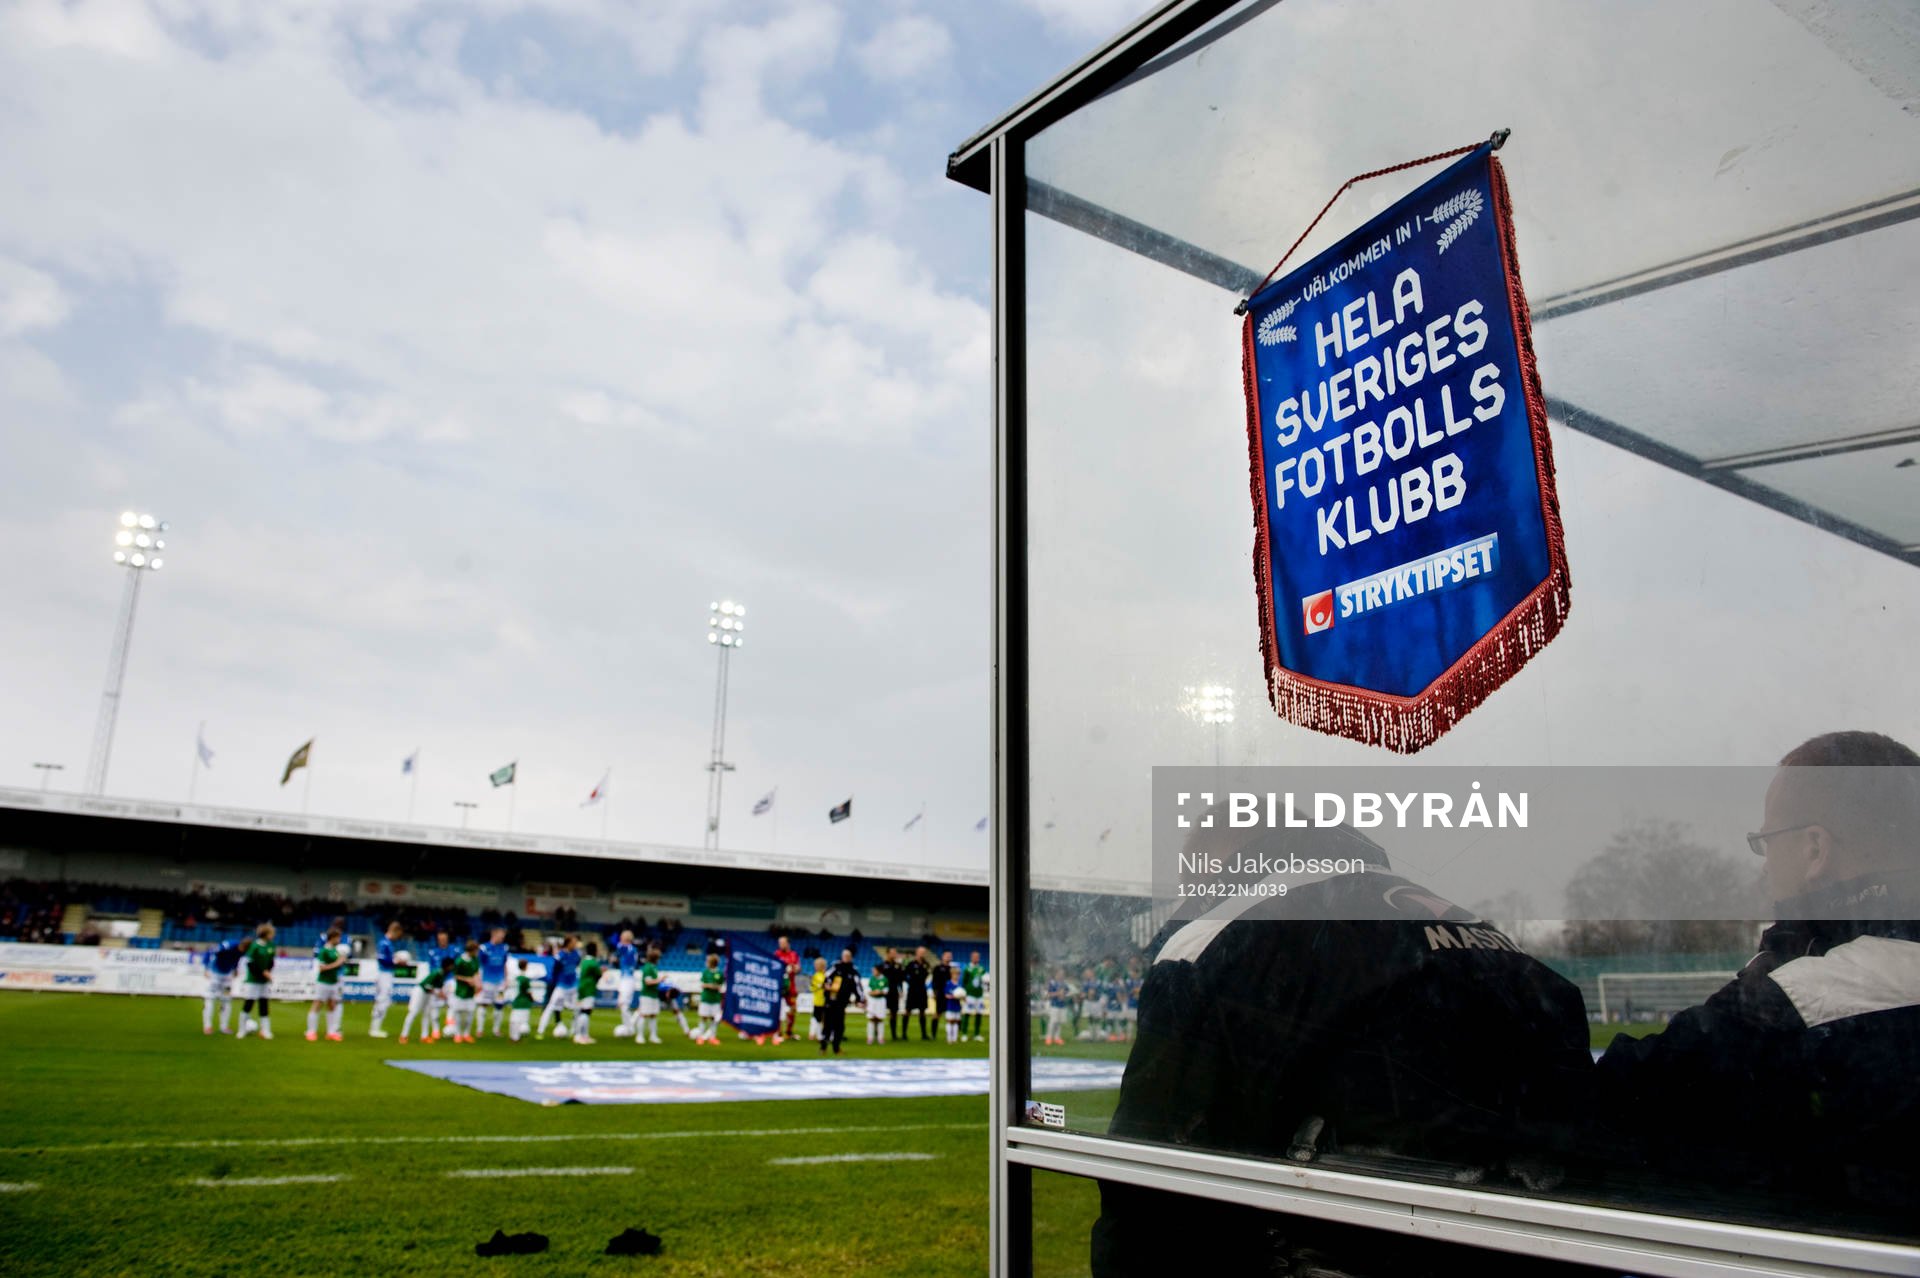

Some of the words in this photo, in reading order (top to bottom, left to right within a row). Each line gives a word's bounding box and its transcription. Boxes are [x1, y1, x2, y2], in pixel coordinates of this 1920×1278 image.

[1303, 238, 1392, 303] VÄLKOMMEN
[1395, 224, 1412, 246] IN
[1314, 267, 1425, 368] HELA
[1275, 299, 1489, 448] SVERIGES
[1275, 362, 1506, 510] FOTBOLLS
[1316, 452, 1468, 556] KLUBB
[1340, 541, 1494, 618] STRYKTIPSET
